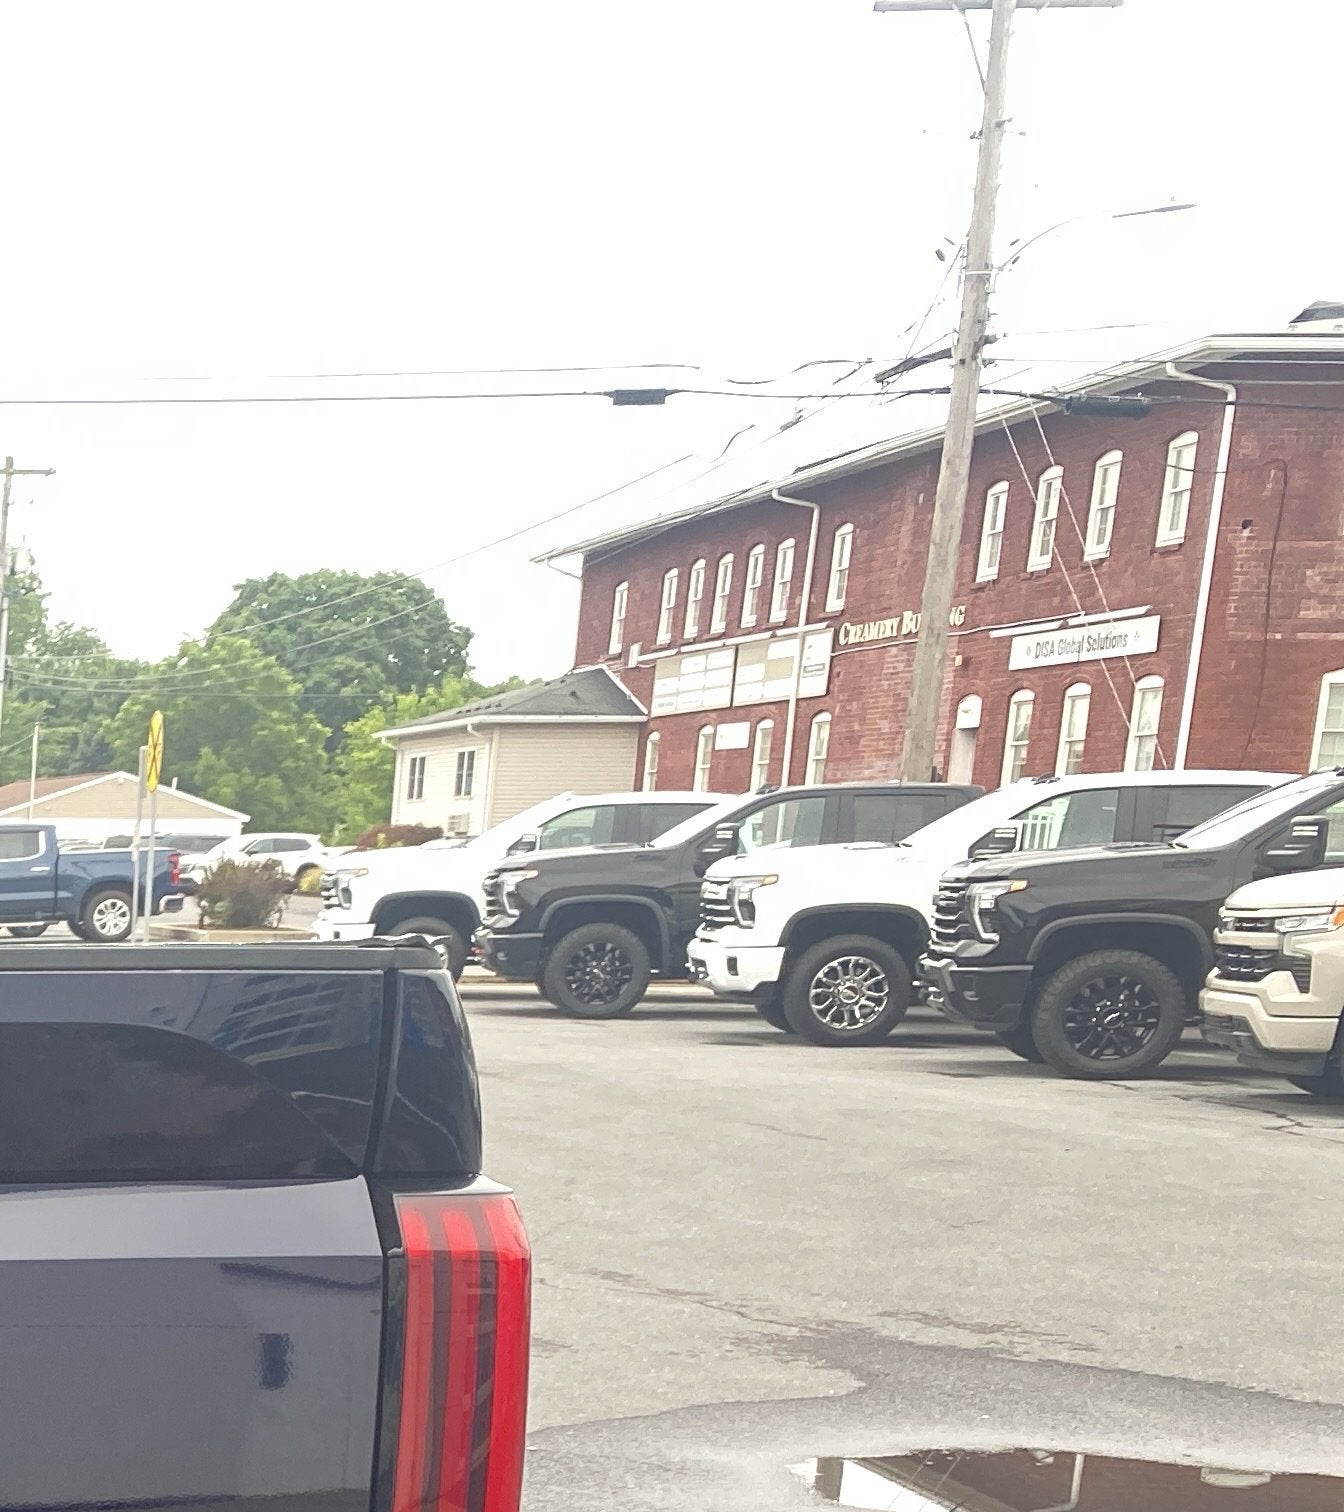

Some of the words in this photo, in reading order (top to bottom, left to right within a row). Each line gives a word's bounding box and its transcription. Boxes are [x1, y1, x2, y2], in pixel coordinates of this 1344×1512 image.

[1035, 640, 1055, 659] DISA
[1057, 634, 1085, 656] Global
[1086, 632, 1129, 653] Solutions
